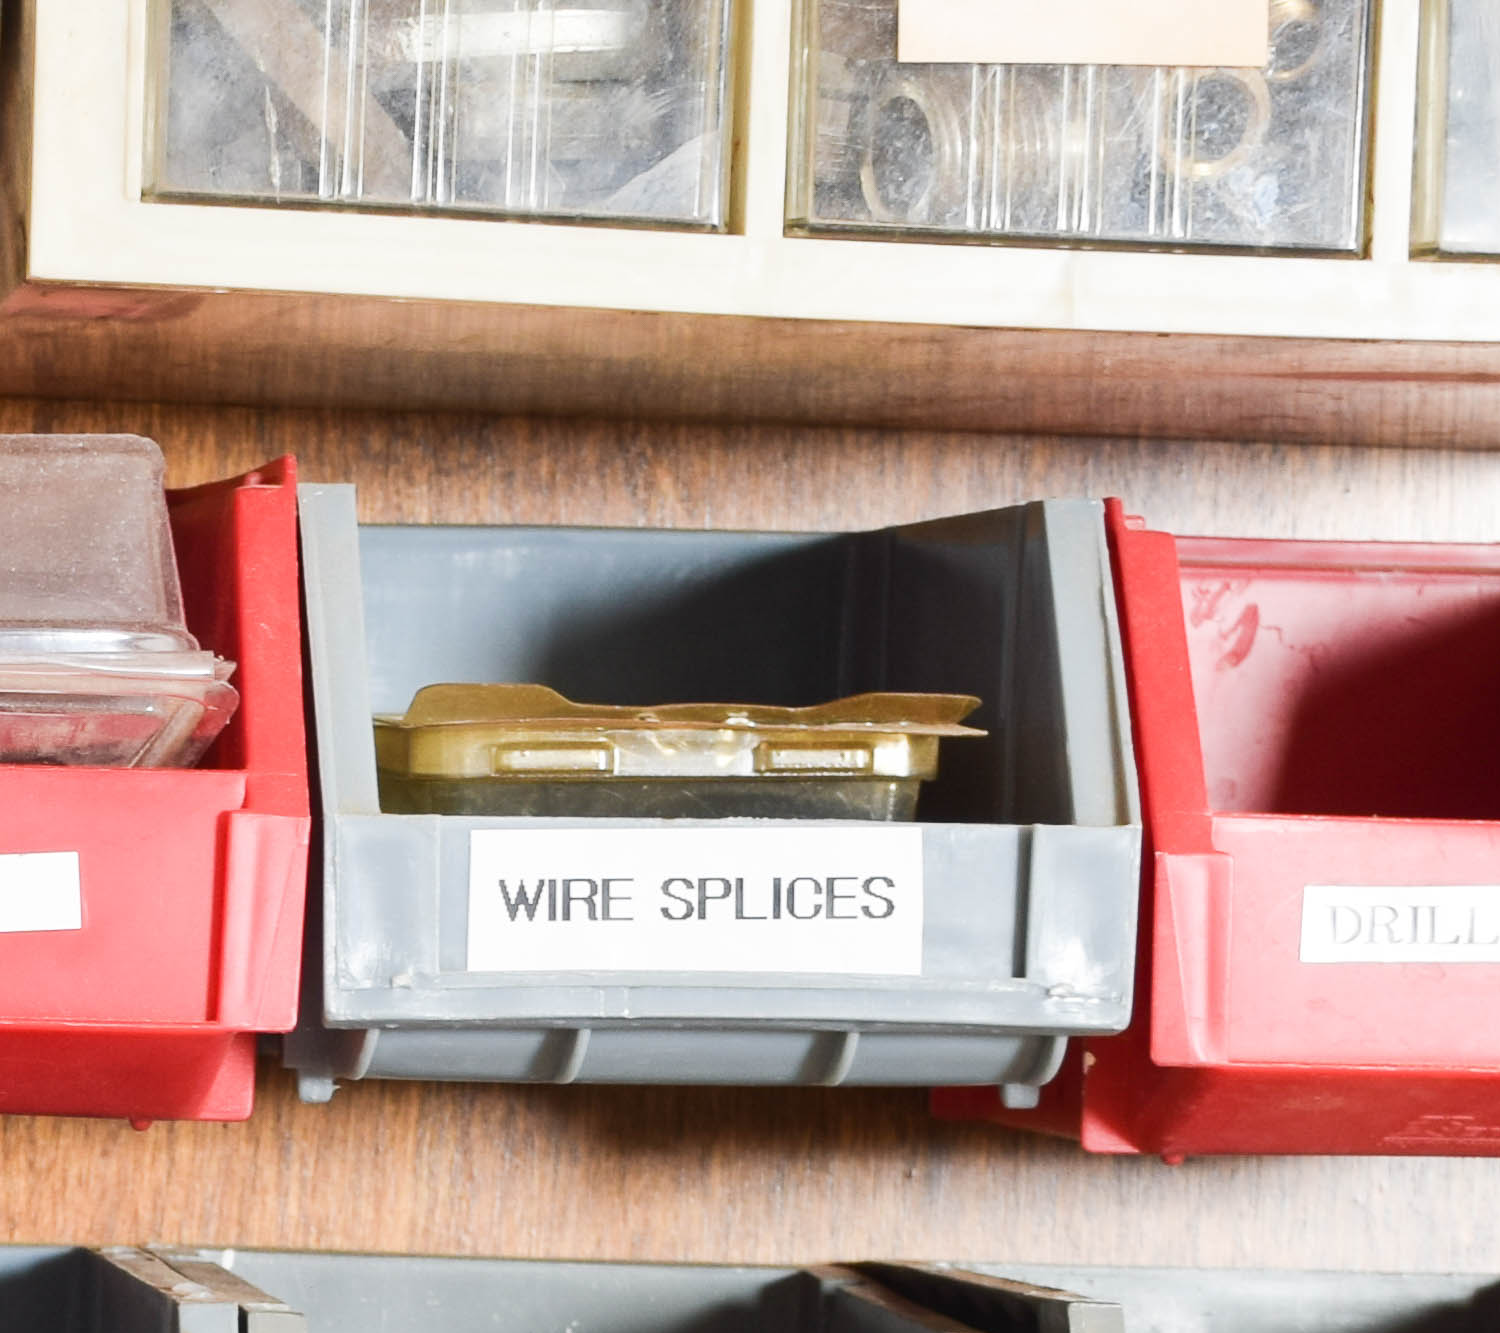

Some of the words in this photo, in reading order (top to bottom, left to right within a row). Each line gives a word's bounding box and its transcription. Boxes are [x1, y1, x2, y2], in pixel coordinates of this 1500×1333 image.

[498, 877, 635, 923] WIRE
[659, 876, 896, 921] SPLICES
[1330, 905, 1500, 945] DRILL
